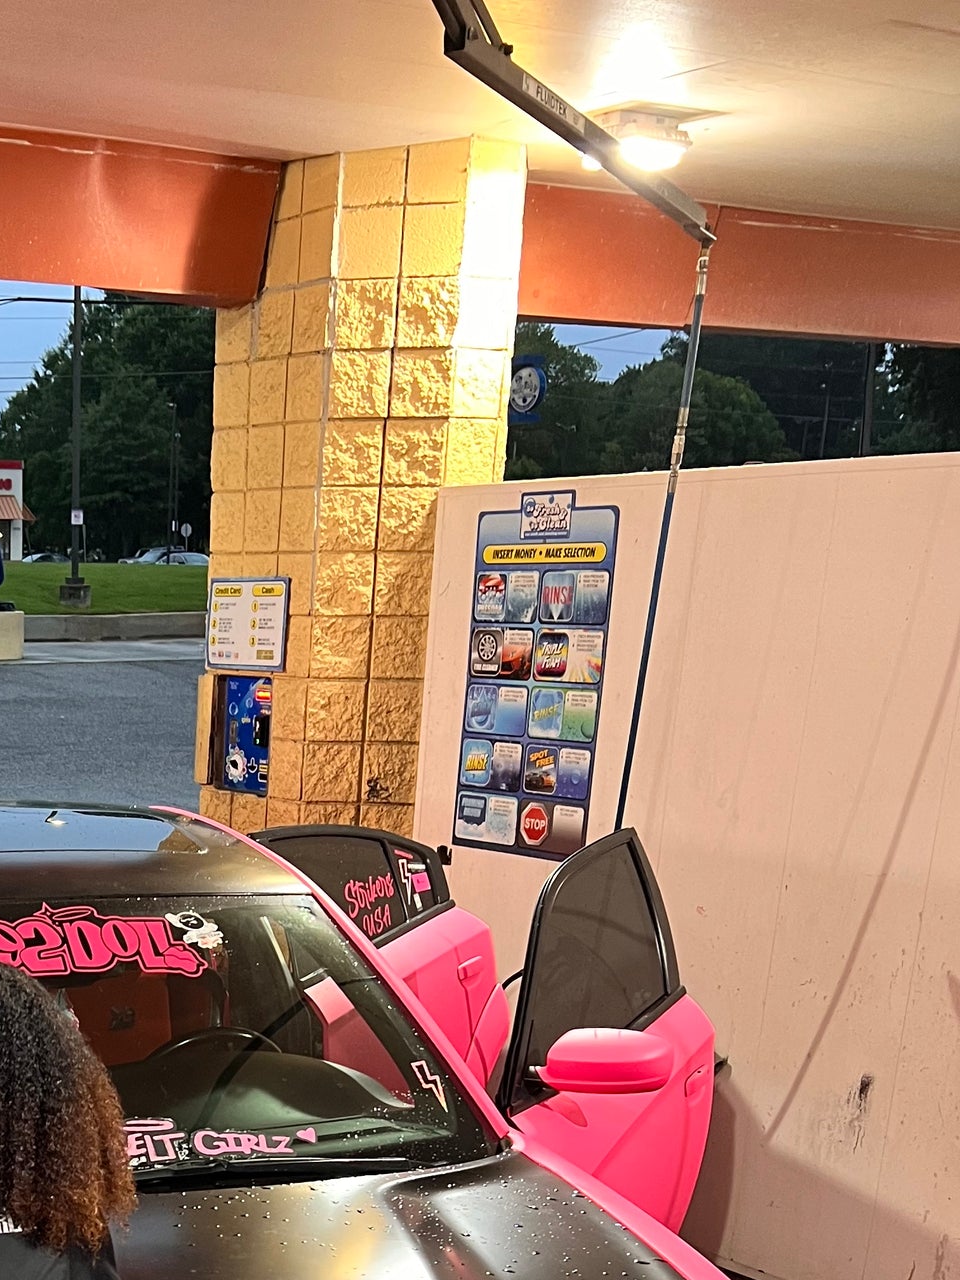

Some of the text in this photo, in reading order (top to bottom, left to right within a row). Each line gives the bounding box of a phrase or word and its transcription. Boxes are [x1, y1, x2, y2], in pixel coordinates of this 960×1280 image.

[536, 516, 567, 532] Clean
[492, 547, 596, 559] INSERT MONEY MAKE SELECTION
[542, 586, 573, 605] RINSE
[465, 753, 489, 772] RINSE
[530, 750, 549, 762] SPOT
[536, 755, 555, 768] FREE
[525, 818, 546, 831] STOP
[363, 903, 392, 936] USA
